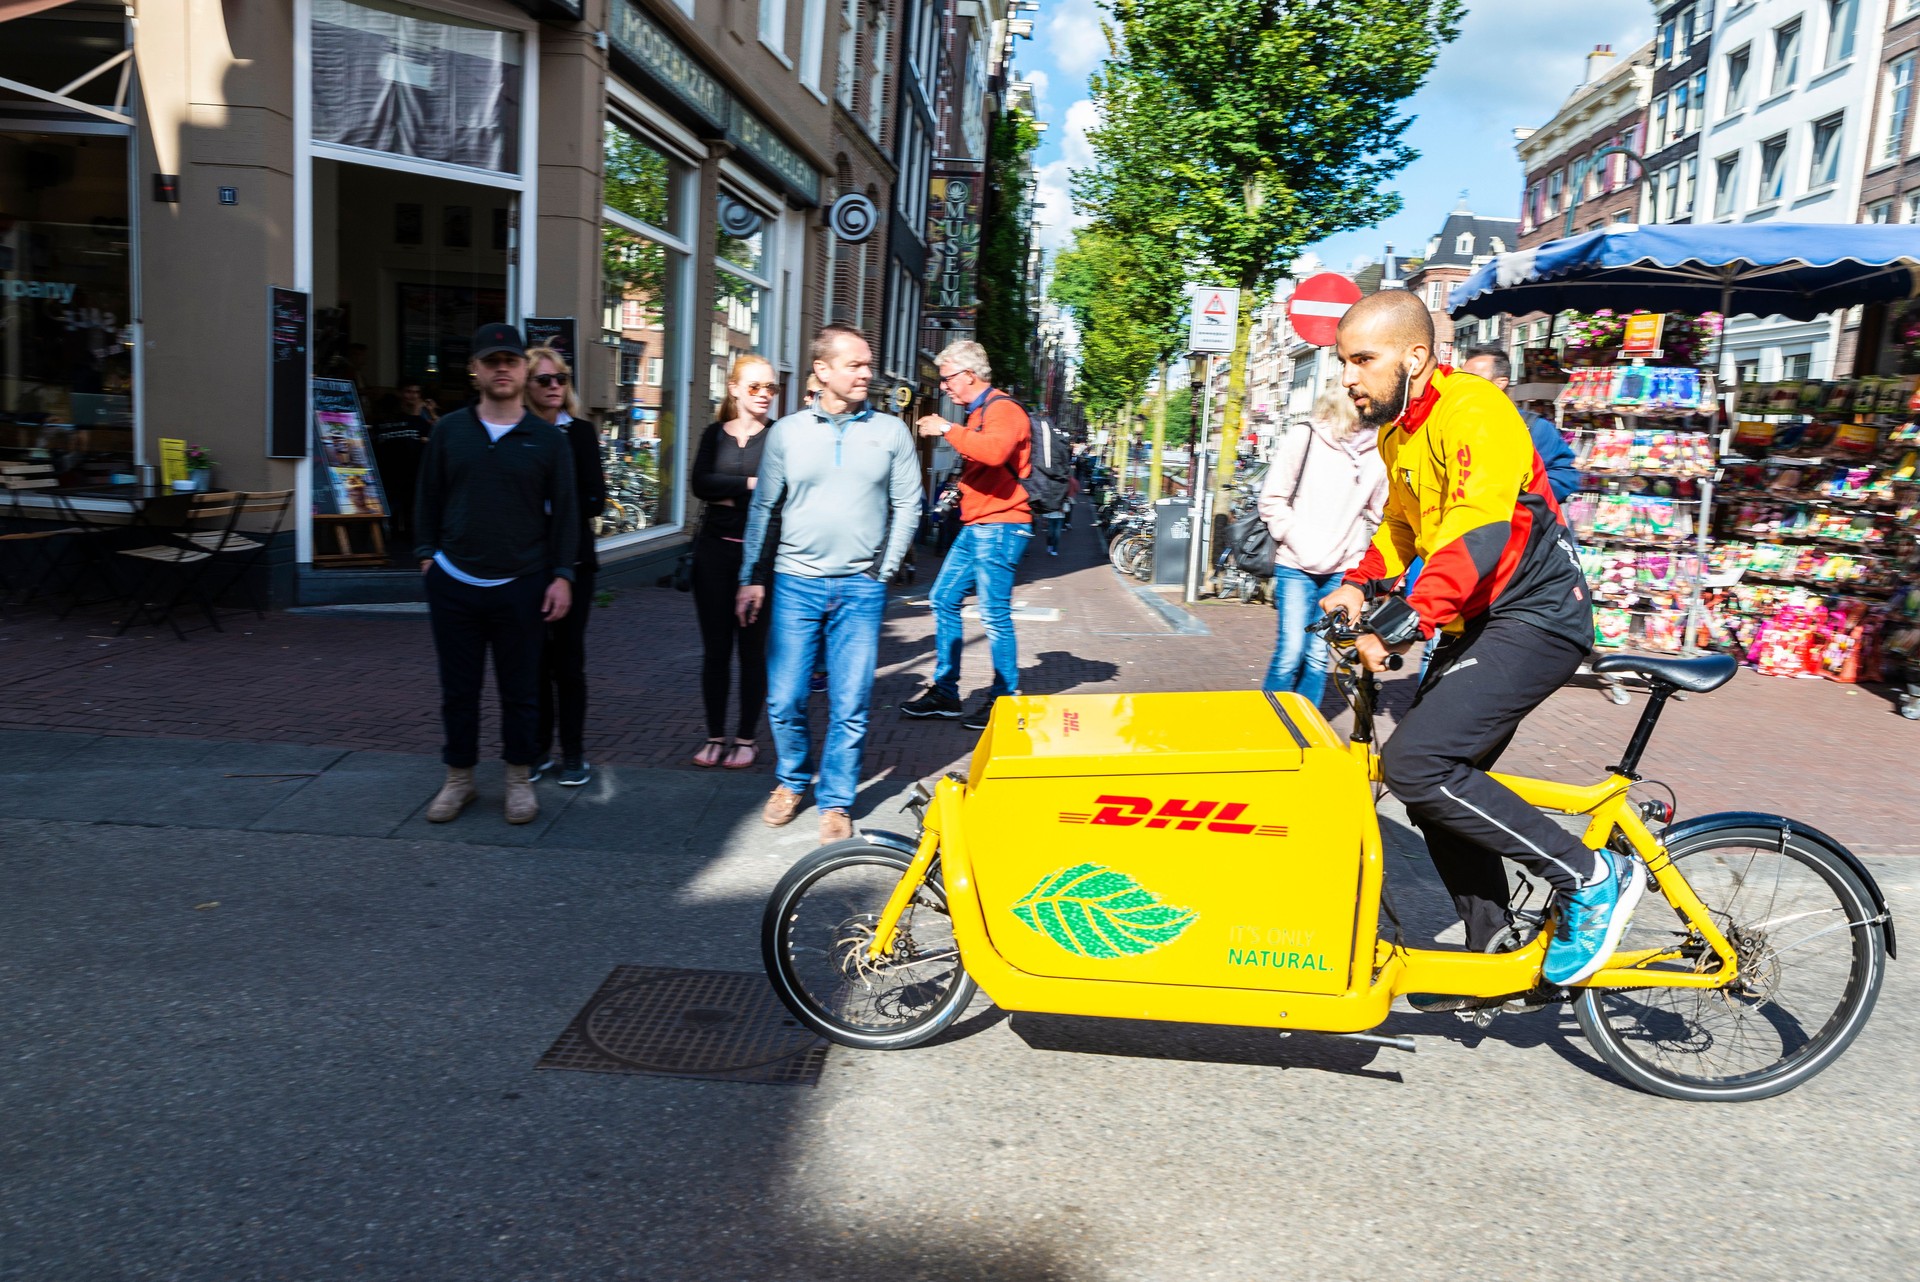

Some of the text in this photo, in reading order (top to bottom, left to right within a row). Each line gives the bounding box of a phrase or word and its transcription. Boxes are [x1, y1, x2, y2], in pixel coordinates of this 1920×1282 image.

[940, 202, 966, 307] MUSEUM
[1089, 794, 1257, 835] DHL
[1229, 925, 1316, 947] IT'S ONLY
[1228, 948, 1333, 971] NATURAL.
